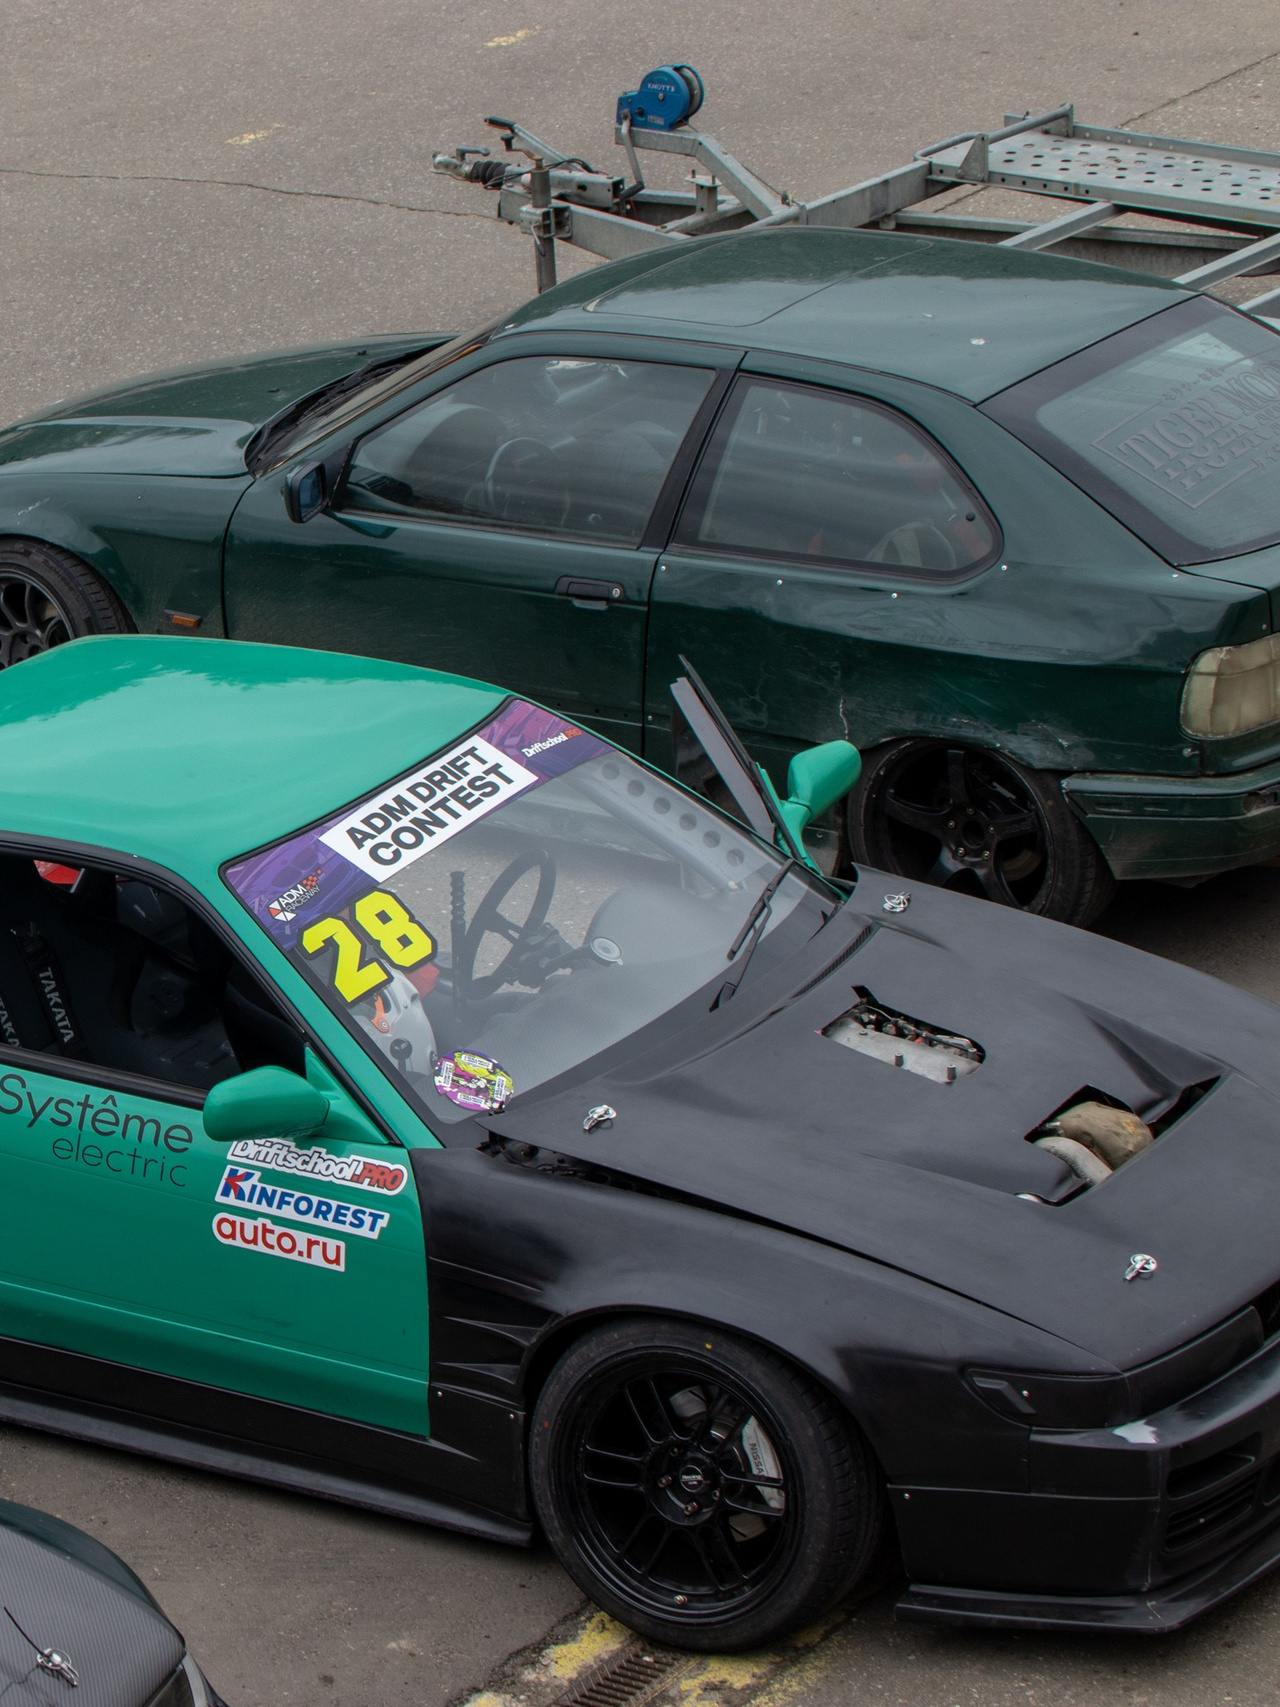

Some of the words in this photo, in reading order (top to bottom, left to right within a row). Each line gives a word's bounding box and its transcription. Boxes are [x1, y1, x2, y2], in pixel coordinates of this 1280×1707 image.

[1115, 397, 1239, 472] TIGER
[346, 794, 418, 850] ADM
[405, 745, 489, 804] DRIFT
[368, 762, 515, 866] CONTEST
[278, 884, 307, 908] ADM
[286, 885, 320, 912] RACEWAY
[301, 890, 433, 1003] 28
[39, 966, 75, 1043] TAKATA
[52, 1133, 188, 1187] electric
[220, 1167, 385, 1233] KINFOREST
[216, 1217, 341, 1267] auto.ru
[748, 1442, 766, 1475] NISSA
